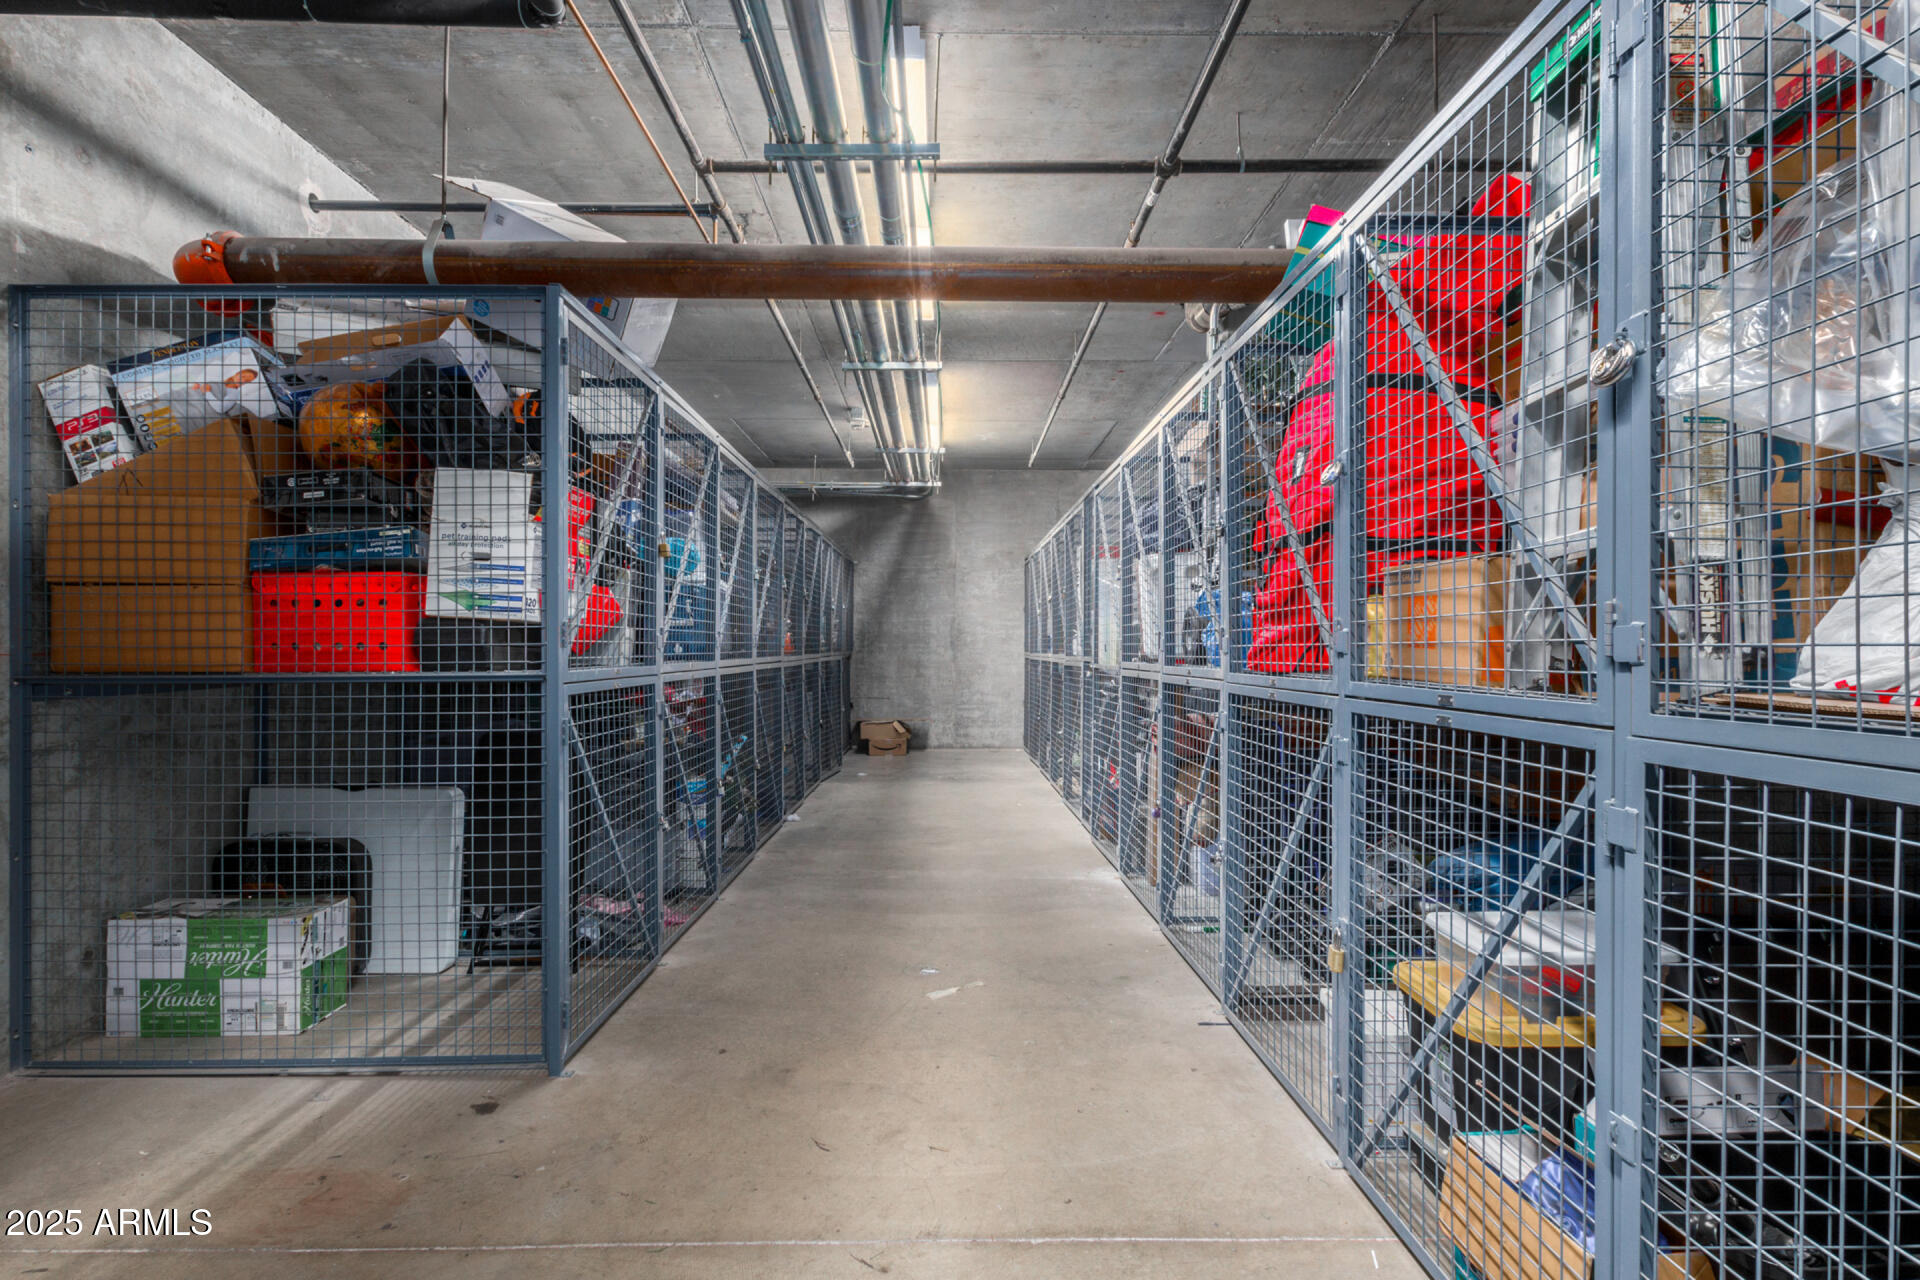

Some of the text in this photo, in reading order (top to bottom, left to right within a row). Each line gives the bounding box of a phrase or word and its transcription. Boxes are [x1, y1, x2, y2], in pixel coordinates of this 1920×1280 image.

[66, 413, 100, 431] PS3
[441, 532, 456, 542] pet
[457, 533, 489, 543] training
[1699, 566, 1716, 632] HUSKY
[188, 947, 268, 977] Hunter
[140, 982, 218, 1010] Hunter
